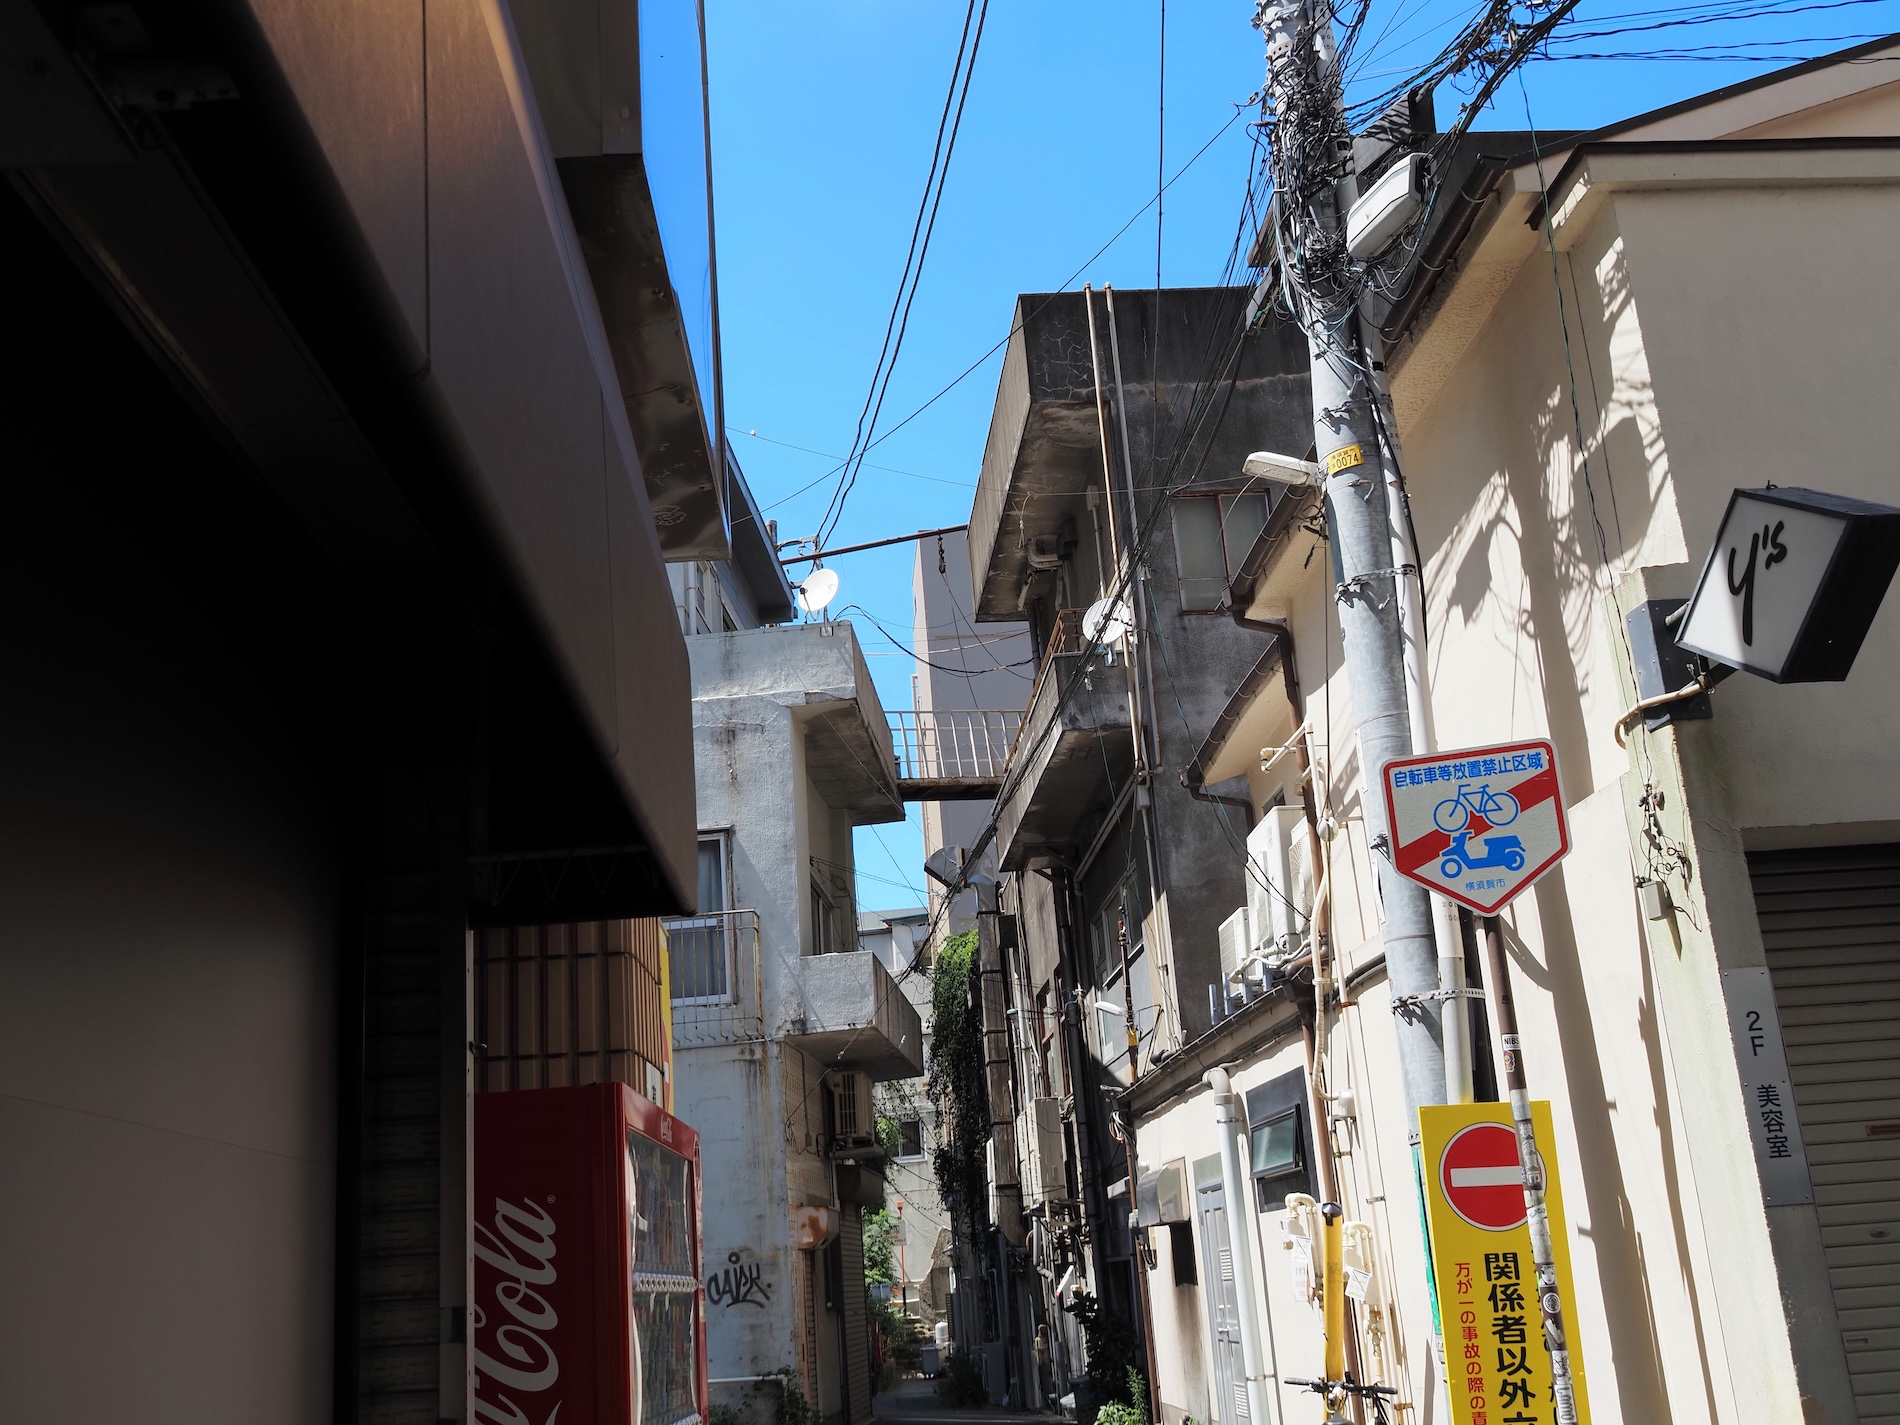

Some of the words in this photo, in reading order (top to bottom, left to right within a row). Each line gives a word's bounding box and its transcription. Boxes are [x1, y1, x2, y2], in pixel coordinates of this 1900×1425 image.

[1336, 453, 1359, 468] 0074
[1394, 752, 1544, 788] 自転車等放置禁止区域
[1465, 878, 1506, 892] 横須賀市
[1746, 1010, 1765, 1057] 2F
[1757, 1083, 1792, 1160] 美容室
[1519, 1123, 1542, 1185] 横須賀市
[1455, 1262, 1488, 1425] 万が一の事故の際の責
